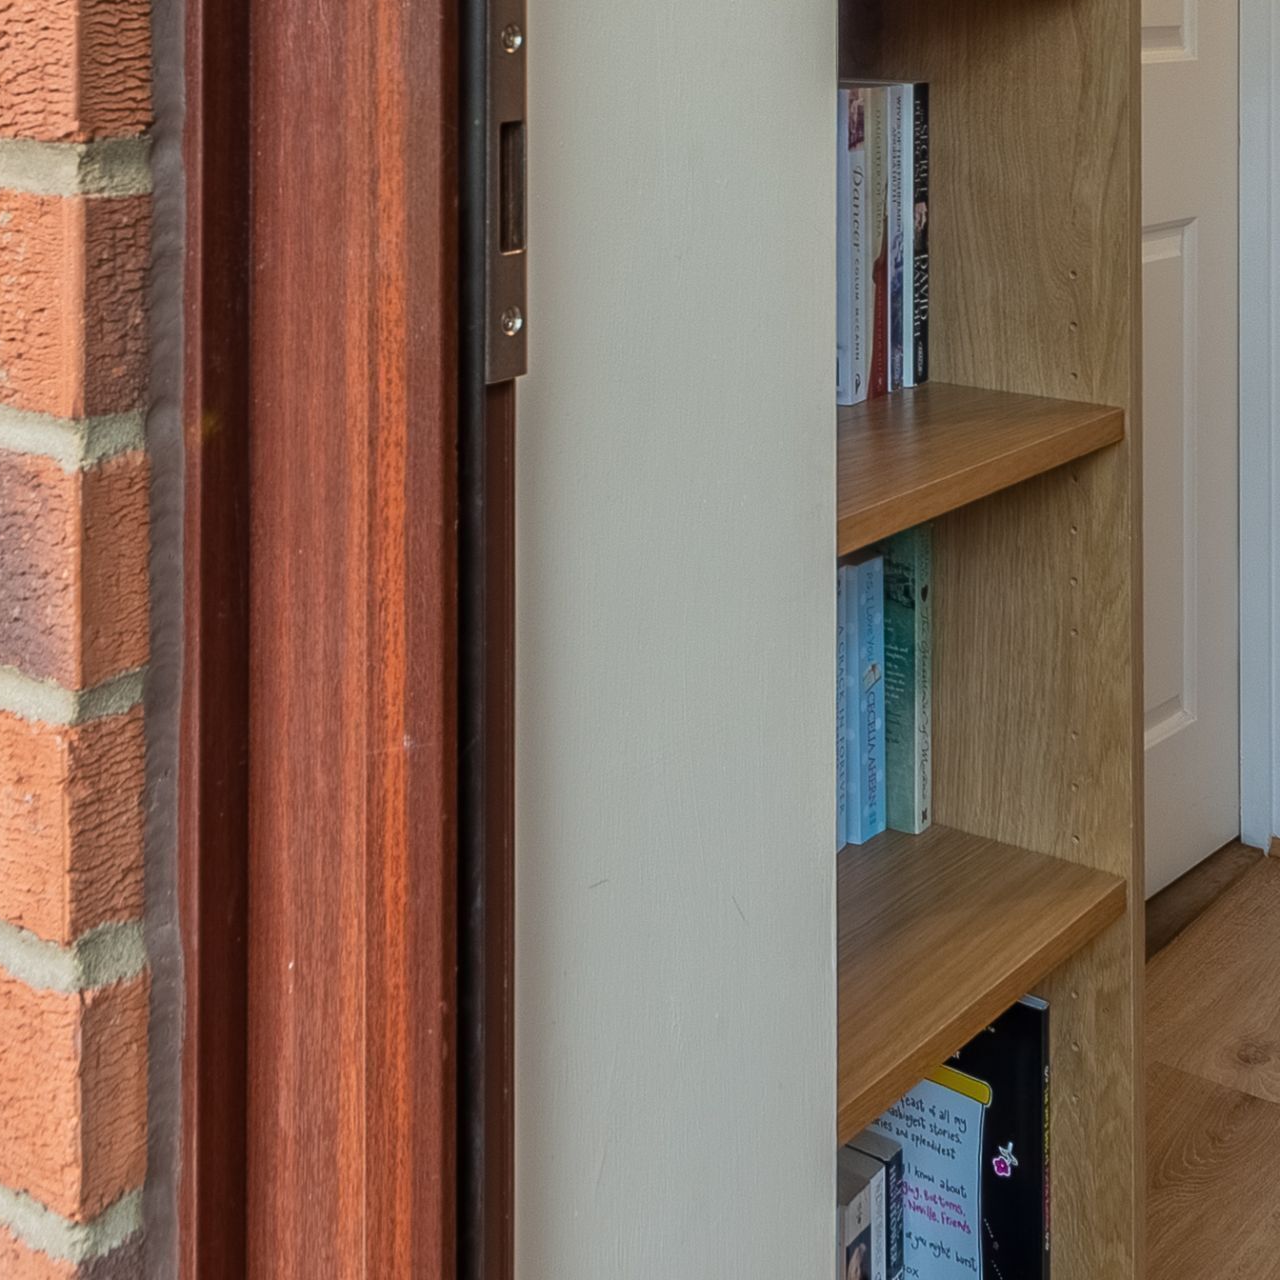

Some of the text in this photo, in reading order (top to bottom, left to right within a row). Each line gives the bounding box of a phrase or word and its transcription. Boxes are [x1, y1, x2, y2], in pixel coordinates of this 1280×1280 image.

[851, 165, 864, 253] Dancer
[920, 253, 929, 321] DAVID
[866, 606, 874, 637] Love
[866, 639, 875, 663] You
[838, 640, 847, 700] CRACK
[866, 691, 877, 809] CECELIA AHERN
[838, 736, 847, 816] FOREVER
[929, 1123, 962, 1145] stories.
[939, 1108, 950, 1124] all
[953, 1116, 967, 1134] my
[911, 1133, 956, 1160] splendidest
[939, 1178, 968, 1199] about
[910, 1235, 927, 1251] you
[928, 1241, 951, 1260] might
[955, 1251, 978, 1273] burst
